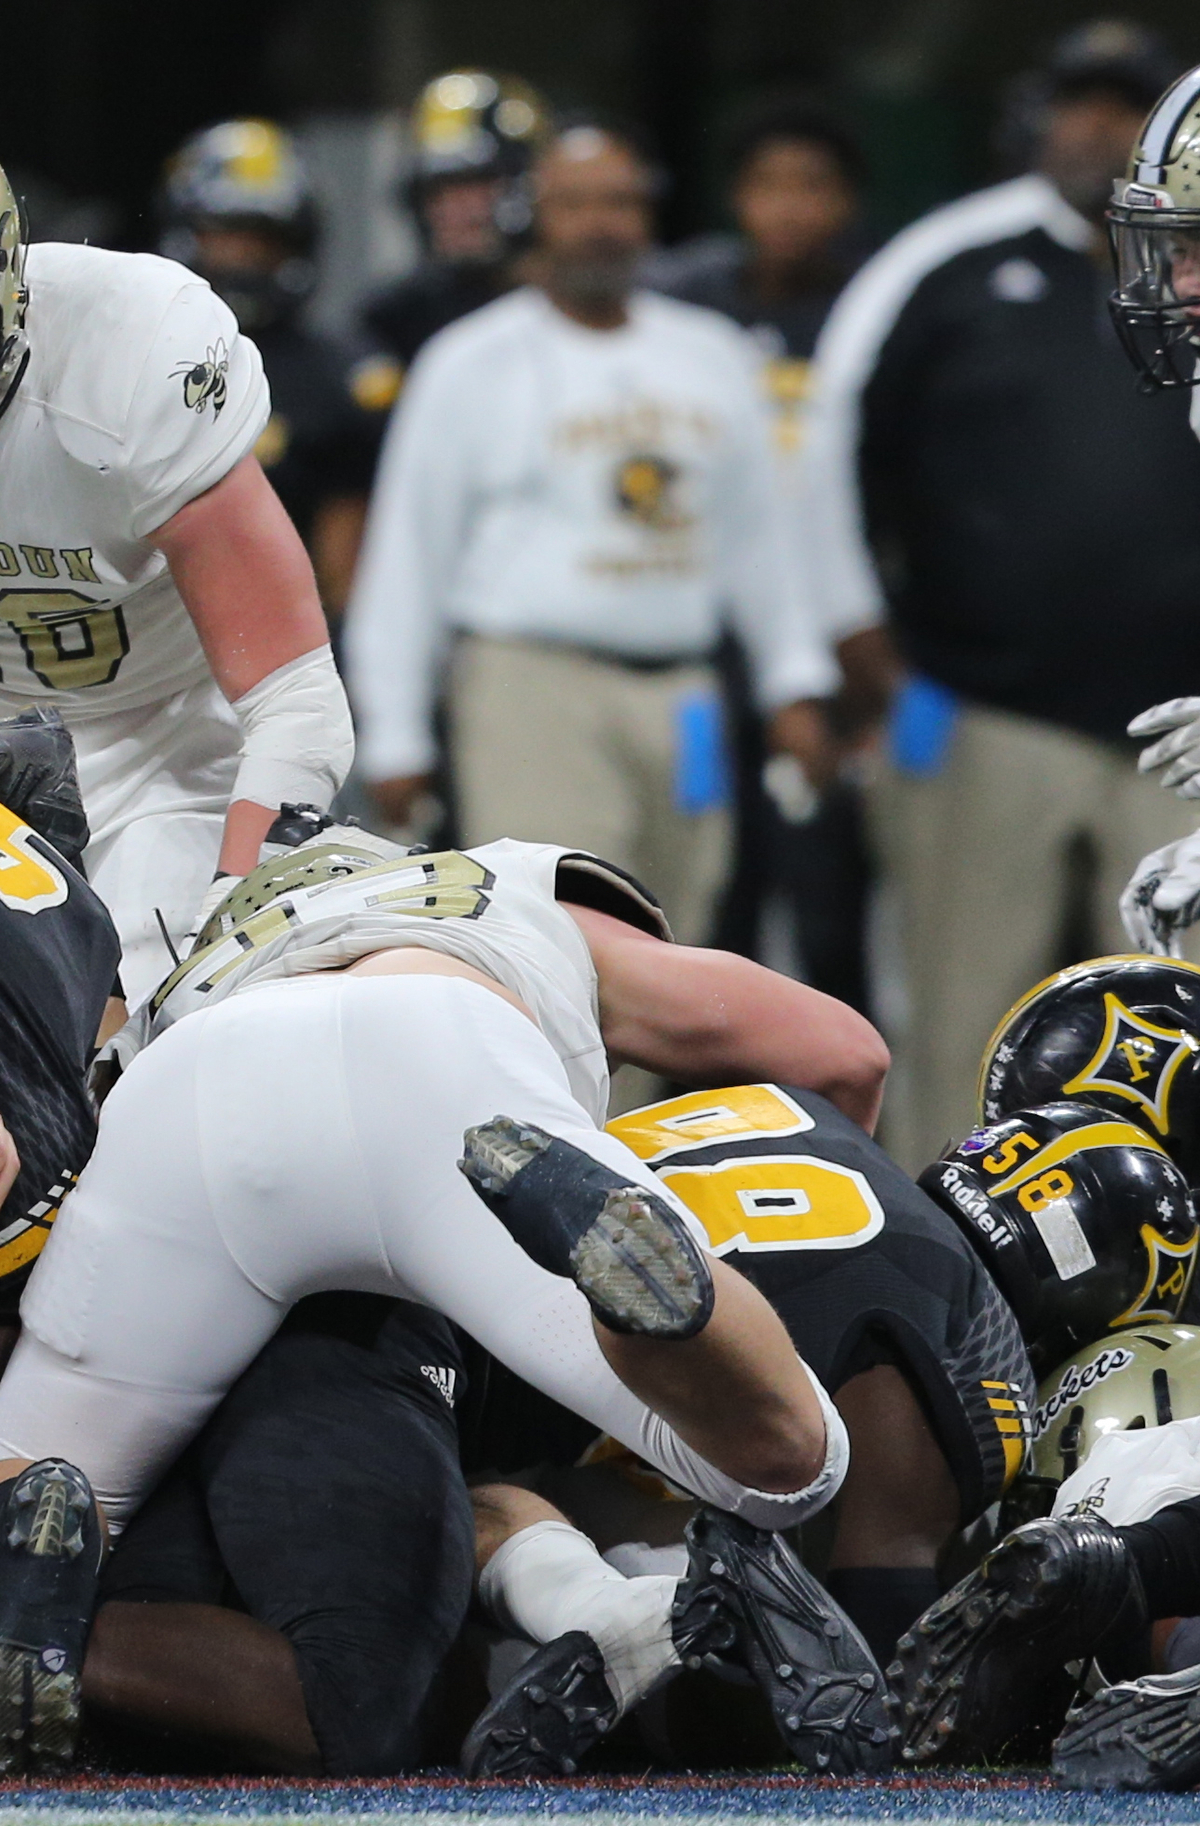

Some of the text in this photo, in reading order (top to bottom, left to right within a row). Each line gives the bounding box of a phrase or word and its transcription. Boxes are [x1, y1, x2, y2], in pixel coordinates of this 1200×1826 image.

[1115, 1035, 1156, 1083] P
[982, 1131, 1075, 1214] 58
[1156, 1260, 1187, 1299] P
